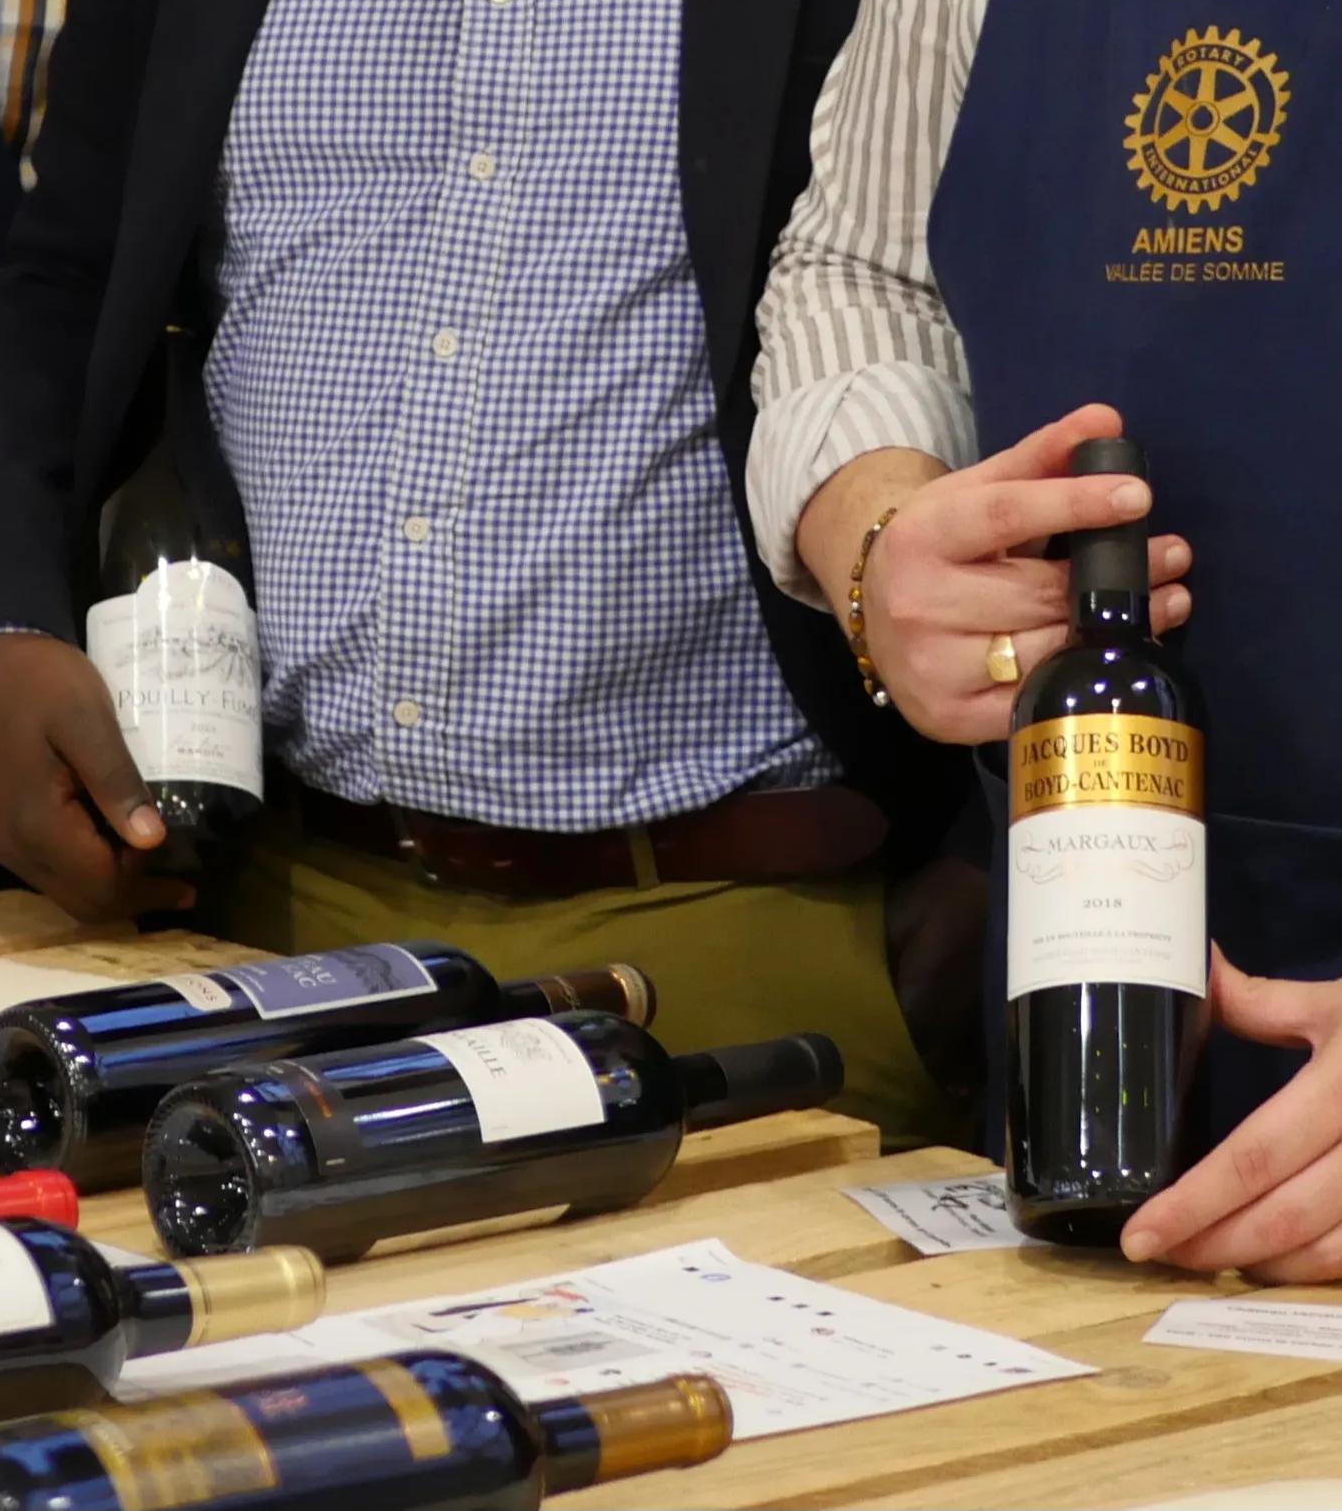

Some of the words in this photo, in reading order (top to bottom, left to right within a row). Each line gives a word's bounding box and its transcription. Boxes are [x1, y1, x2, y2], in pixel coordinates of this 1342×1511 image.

[1176, 46, 1245, 68] ROTARY
[1145, 147, 1258, 192] INTERNATIONAL
[1131, 225, 1244, 254] AMIENS
[1170, 263, 1197, 281] DE
[1202, 261, 1285, 282] SOMME
[1020, 731, 1120, 767] JACQUES
[1129, 732, 1189, 763] BOYD
[1024, 770, 1185, 803] BOYD-CANTENAC
[1047, 835, 1157, 854] MARGAUX
[1083, 898, 1123, 909] 2018
